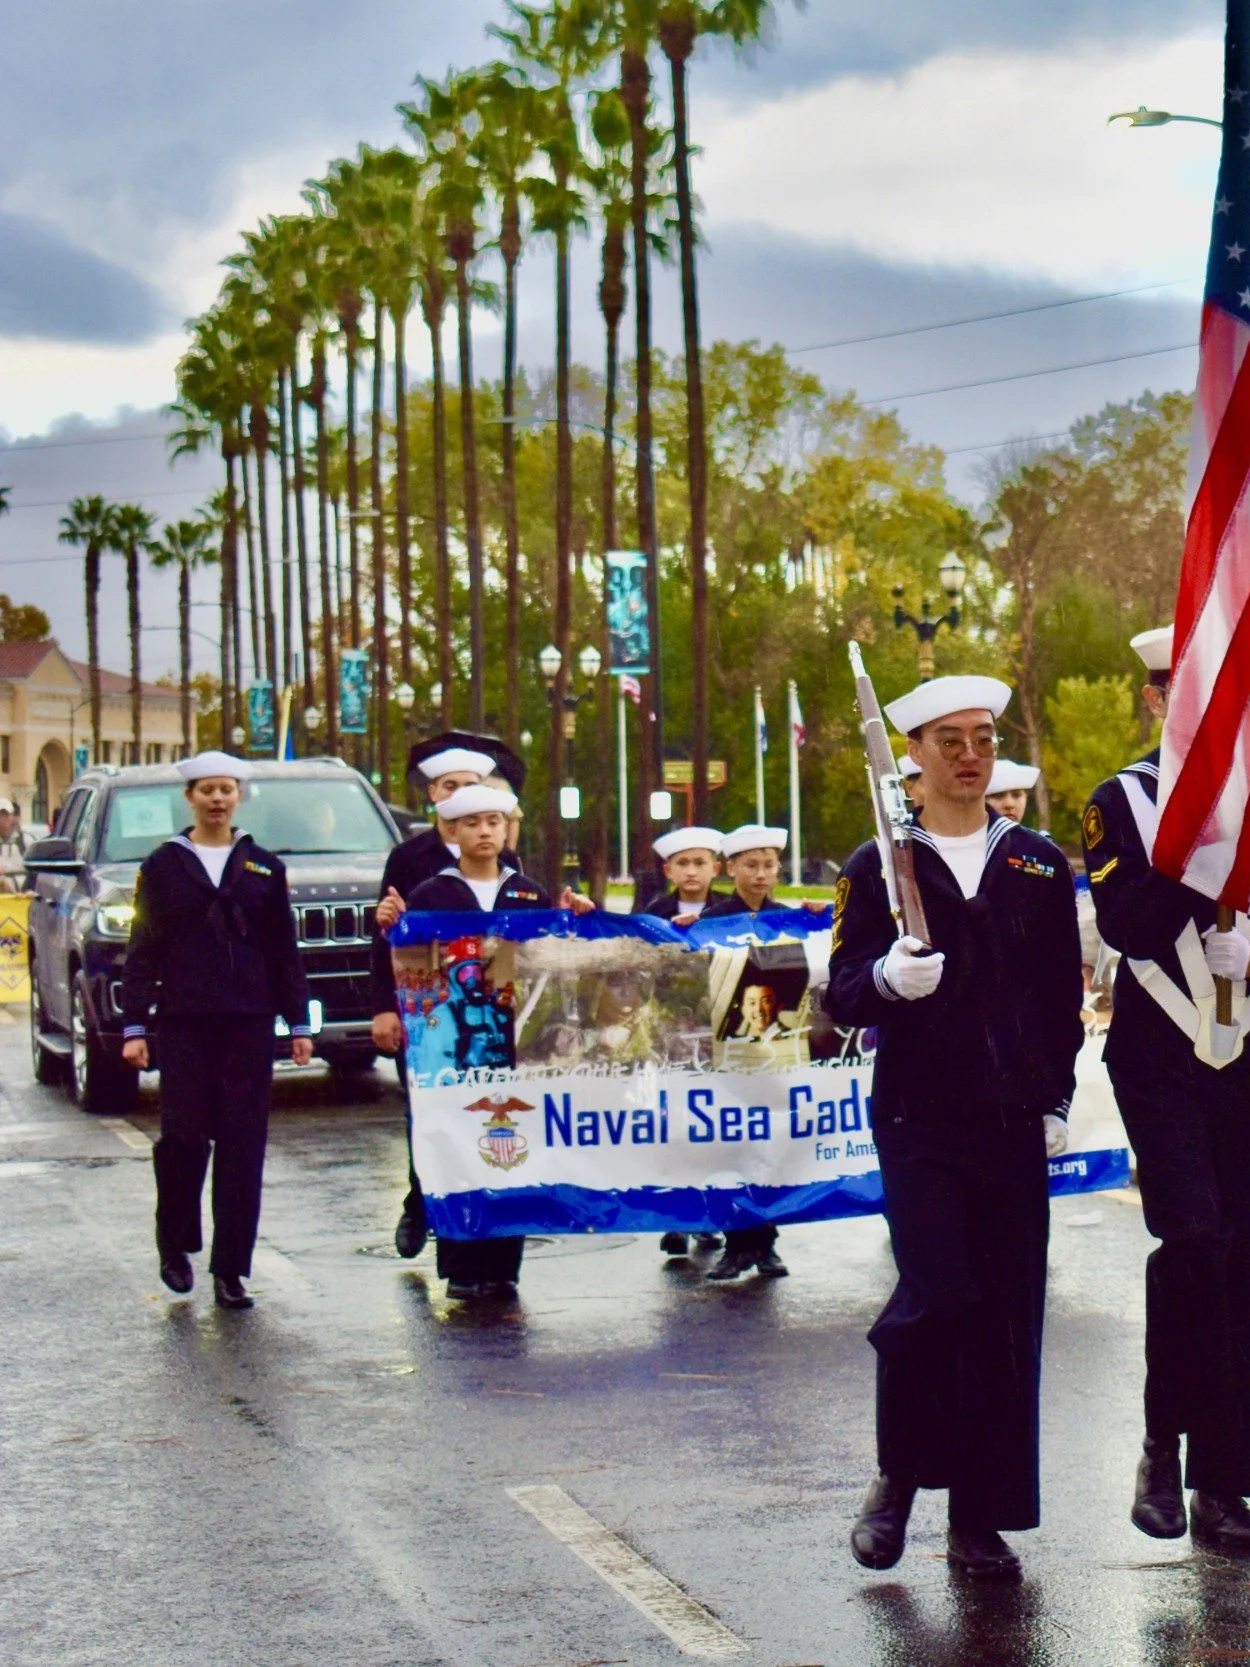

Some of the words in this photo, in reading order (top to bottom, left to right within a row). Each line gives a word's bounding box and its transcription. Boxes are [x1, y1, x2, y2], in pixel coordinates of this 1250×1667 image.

[544, 1089, 668, 1147] Naval
[687, 1088, 771, 1143] Sea
[816, 1142, 840, 1160] For
